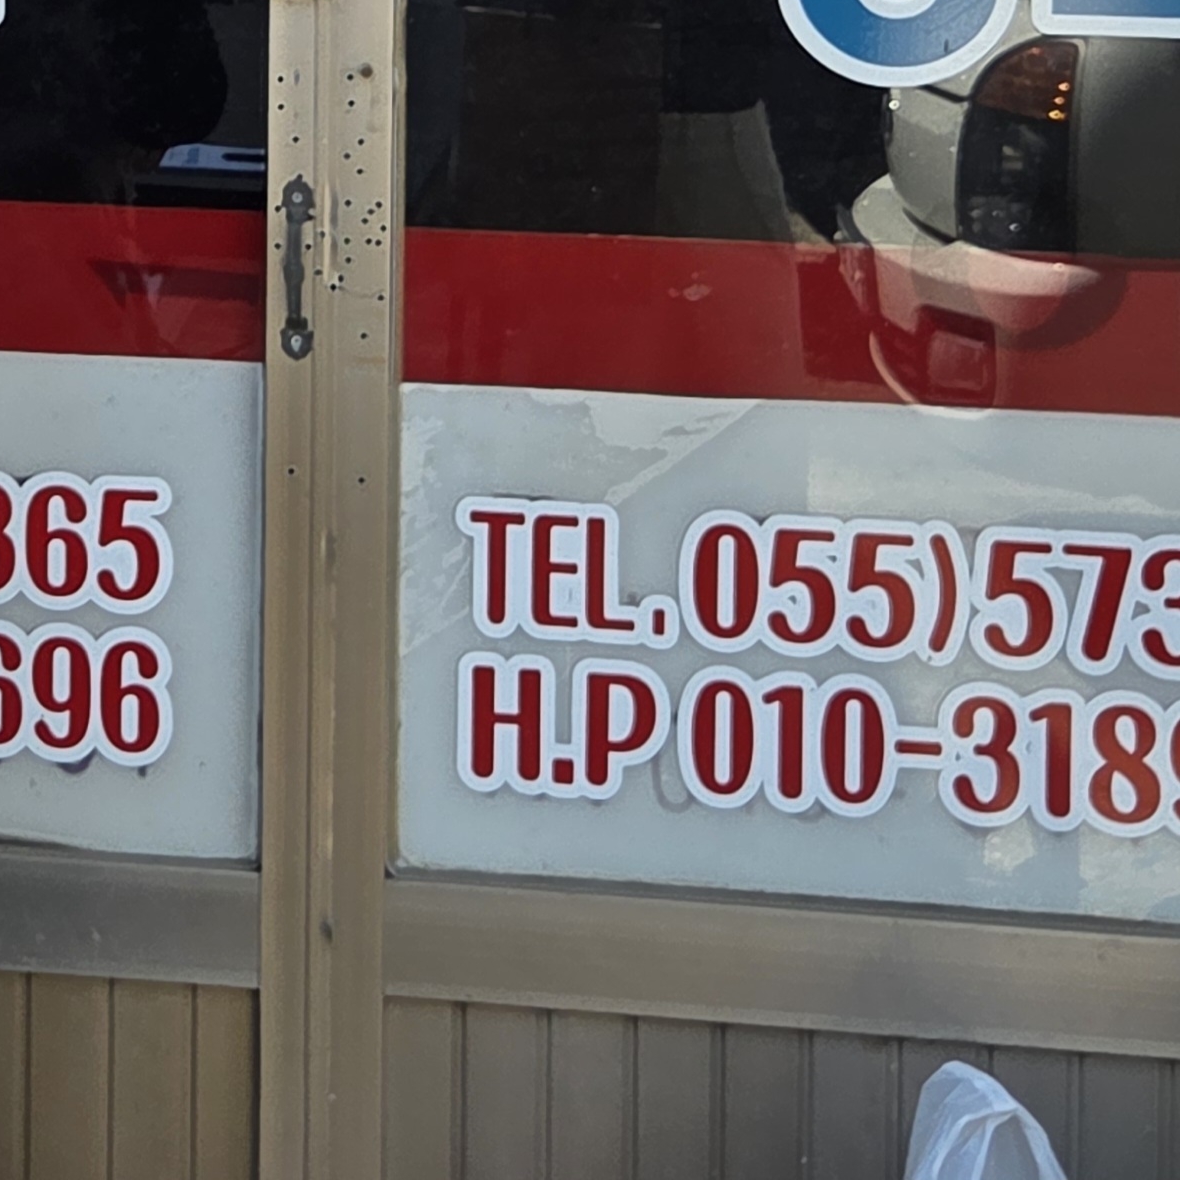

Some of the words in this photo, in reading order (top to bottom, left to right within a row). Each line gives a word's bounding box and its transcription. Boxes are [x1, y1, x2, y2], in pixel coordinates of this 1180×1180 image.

[464, 504, 670, 641] TEL.
[465, 660, 662, 791] H.P
[687, 675, 1180, 828] 010-318
